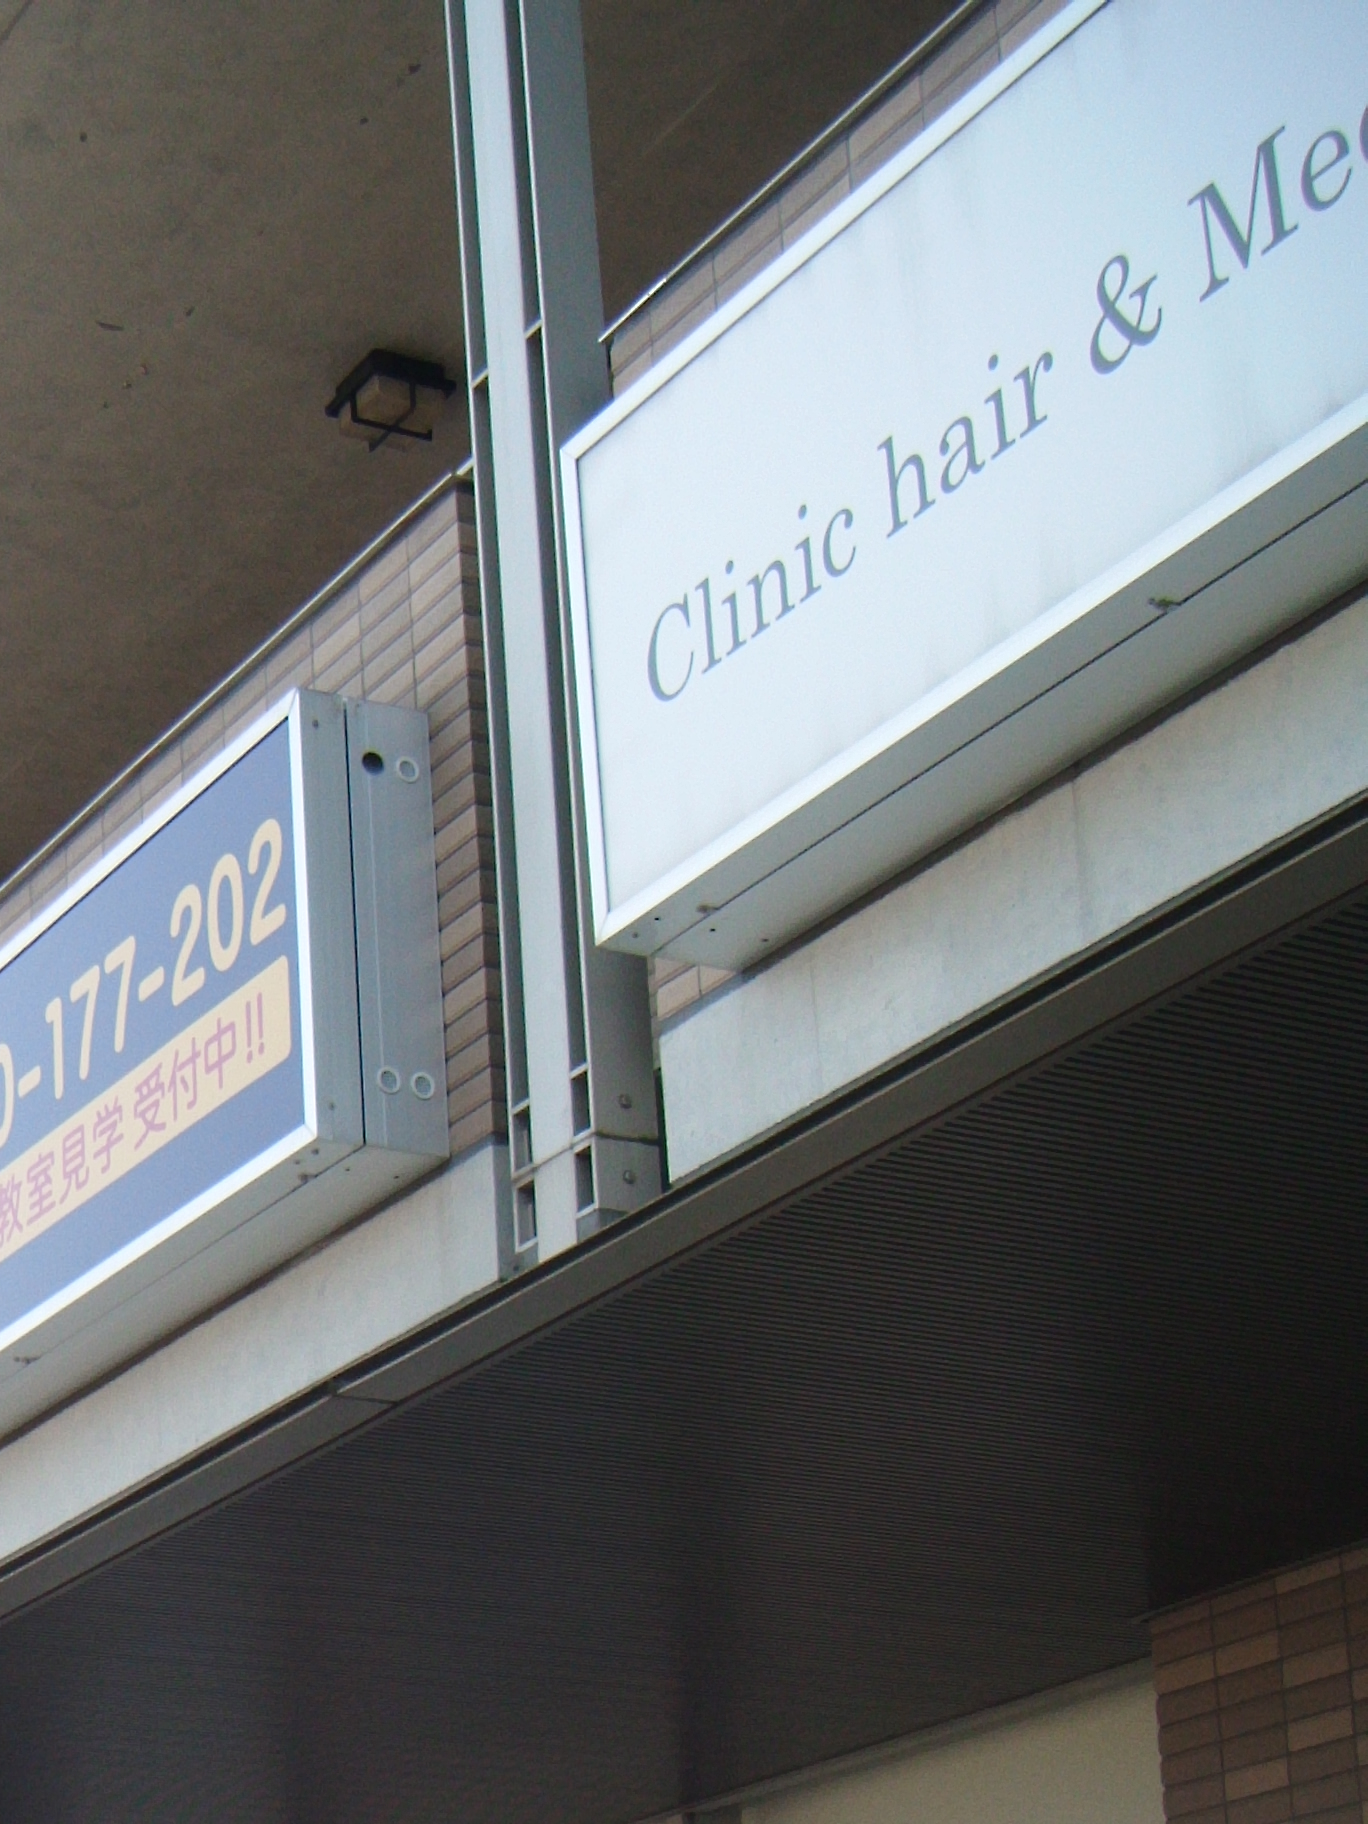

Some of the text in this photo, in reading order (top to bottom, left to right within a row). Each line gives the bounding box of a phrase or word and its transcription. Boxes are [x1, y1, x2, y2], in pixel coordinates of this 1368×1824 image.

[646, 105, 1368, 702] Clinic hair & Me
